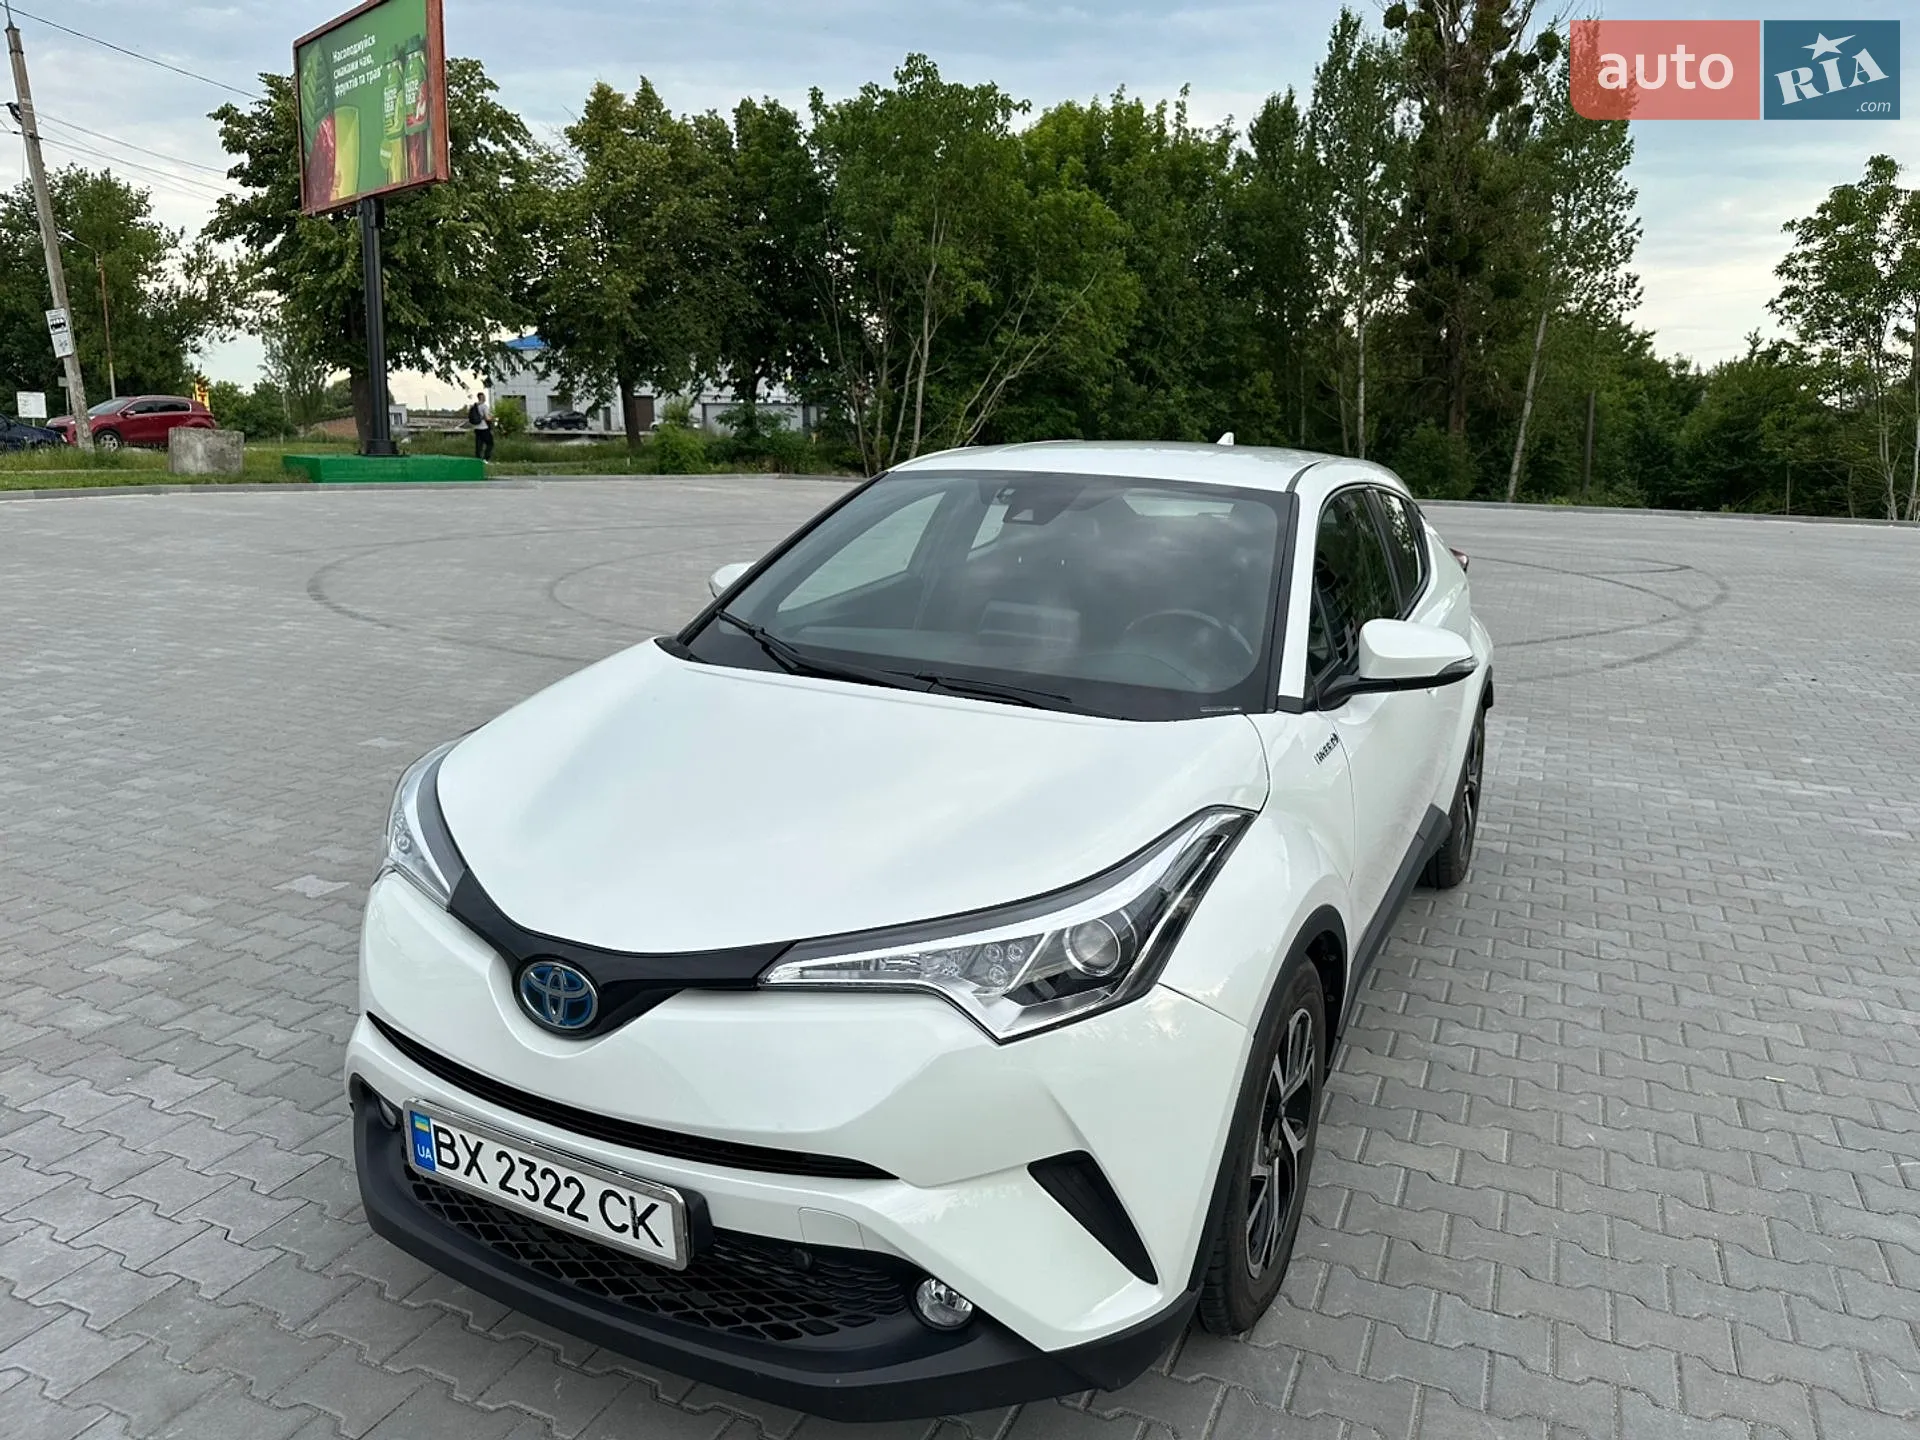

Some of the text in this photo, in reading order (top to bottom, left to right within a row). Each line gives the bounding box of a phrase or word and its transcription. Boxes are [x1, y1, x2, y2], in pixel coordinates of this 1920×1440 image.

[417, 1143, 434, 1161] UA
[433, 1124, 663, 1248] BX 2322 CK
